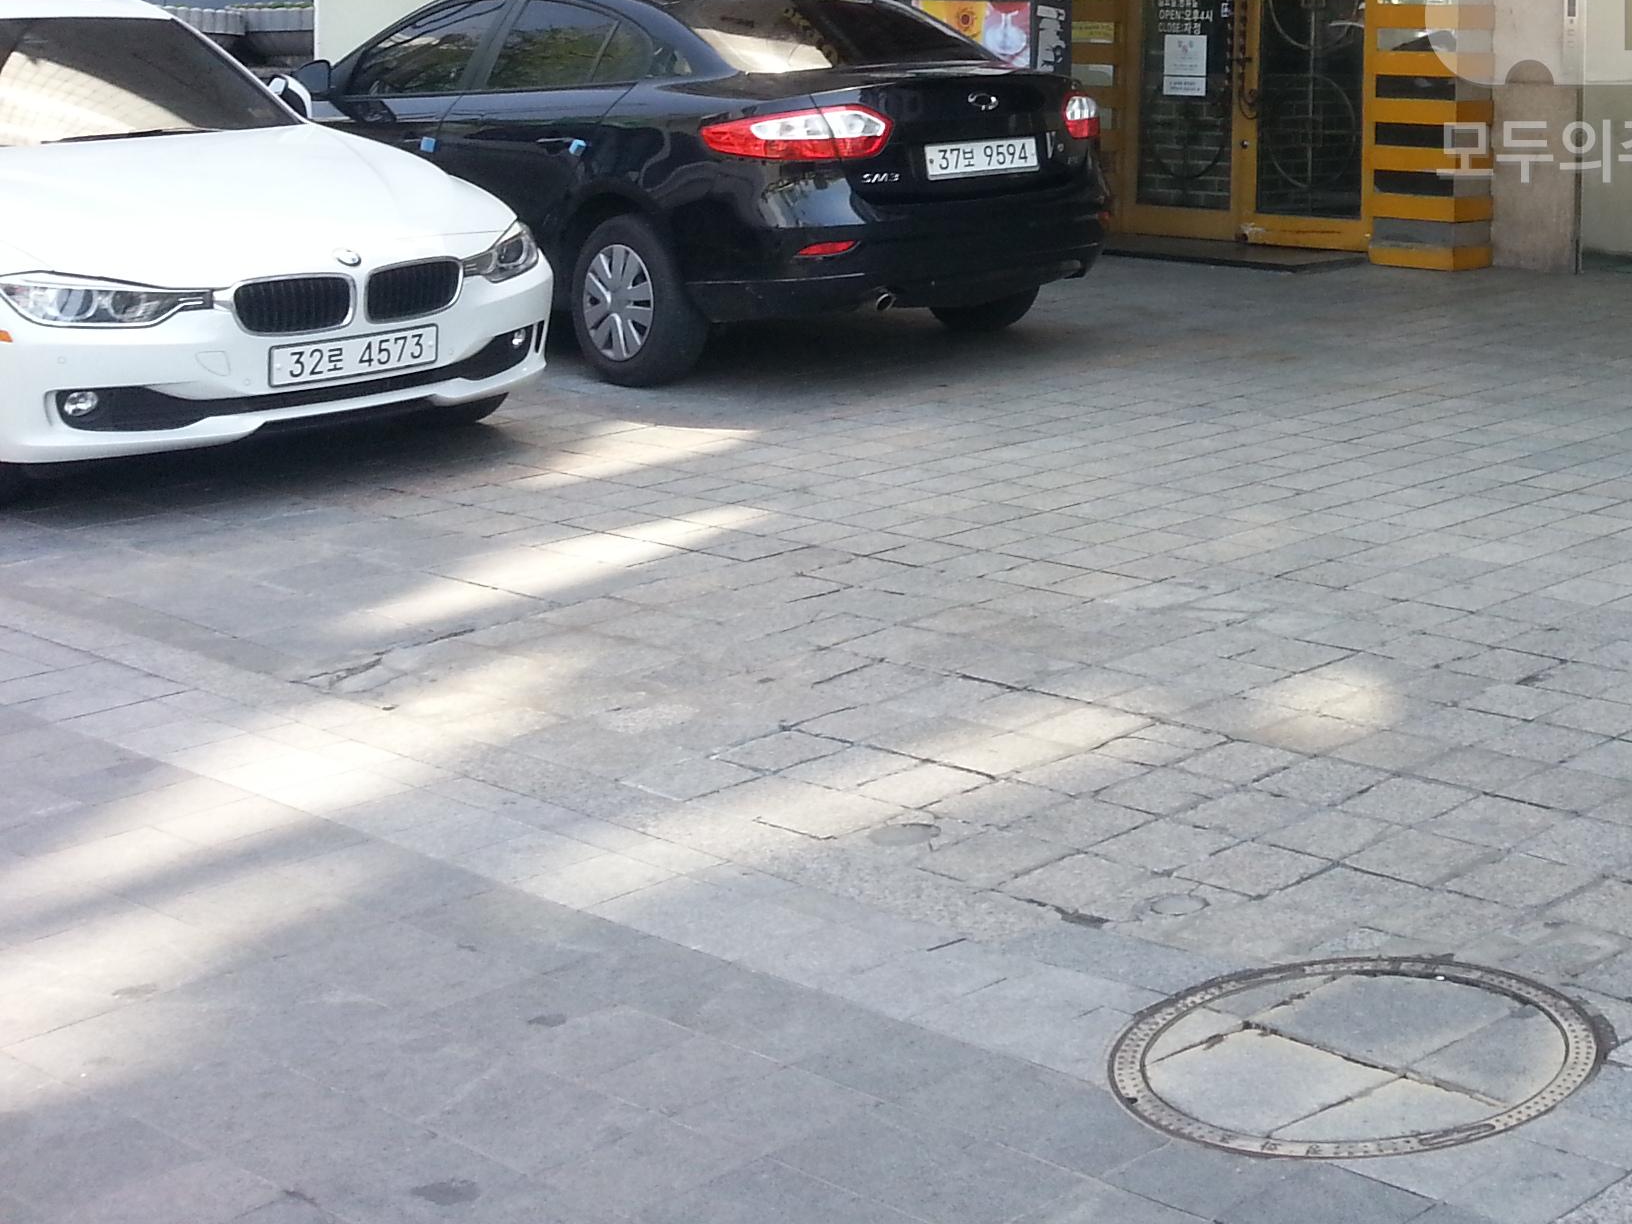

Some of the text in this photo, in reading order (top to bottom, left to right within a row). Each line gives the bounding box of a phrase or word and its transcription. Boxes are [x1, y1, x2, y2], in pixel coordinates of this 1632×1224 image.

[937, 142, 1029, 170] 37보 9594
[861, 172, 900, 184] SM3
[288, 333, 424, 379] 32로 4573
